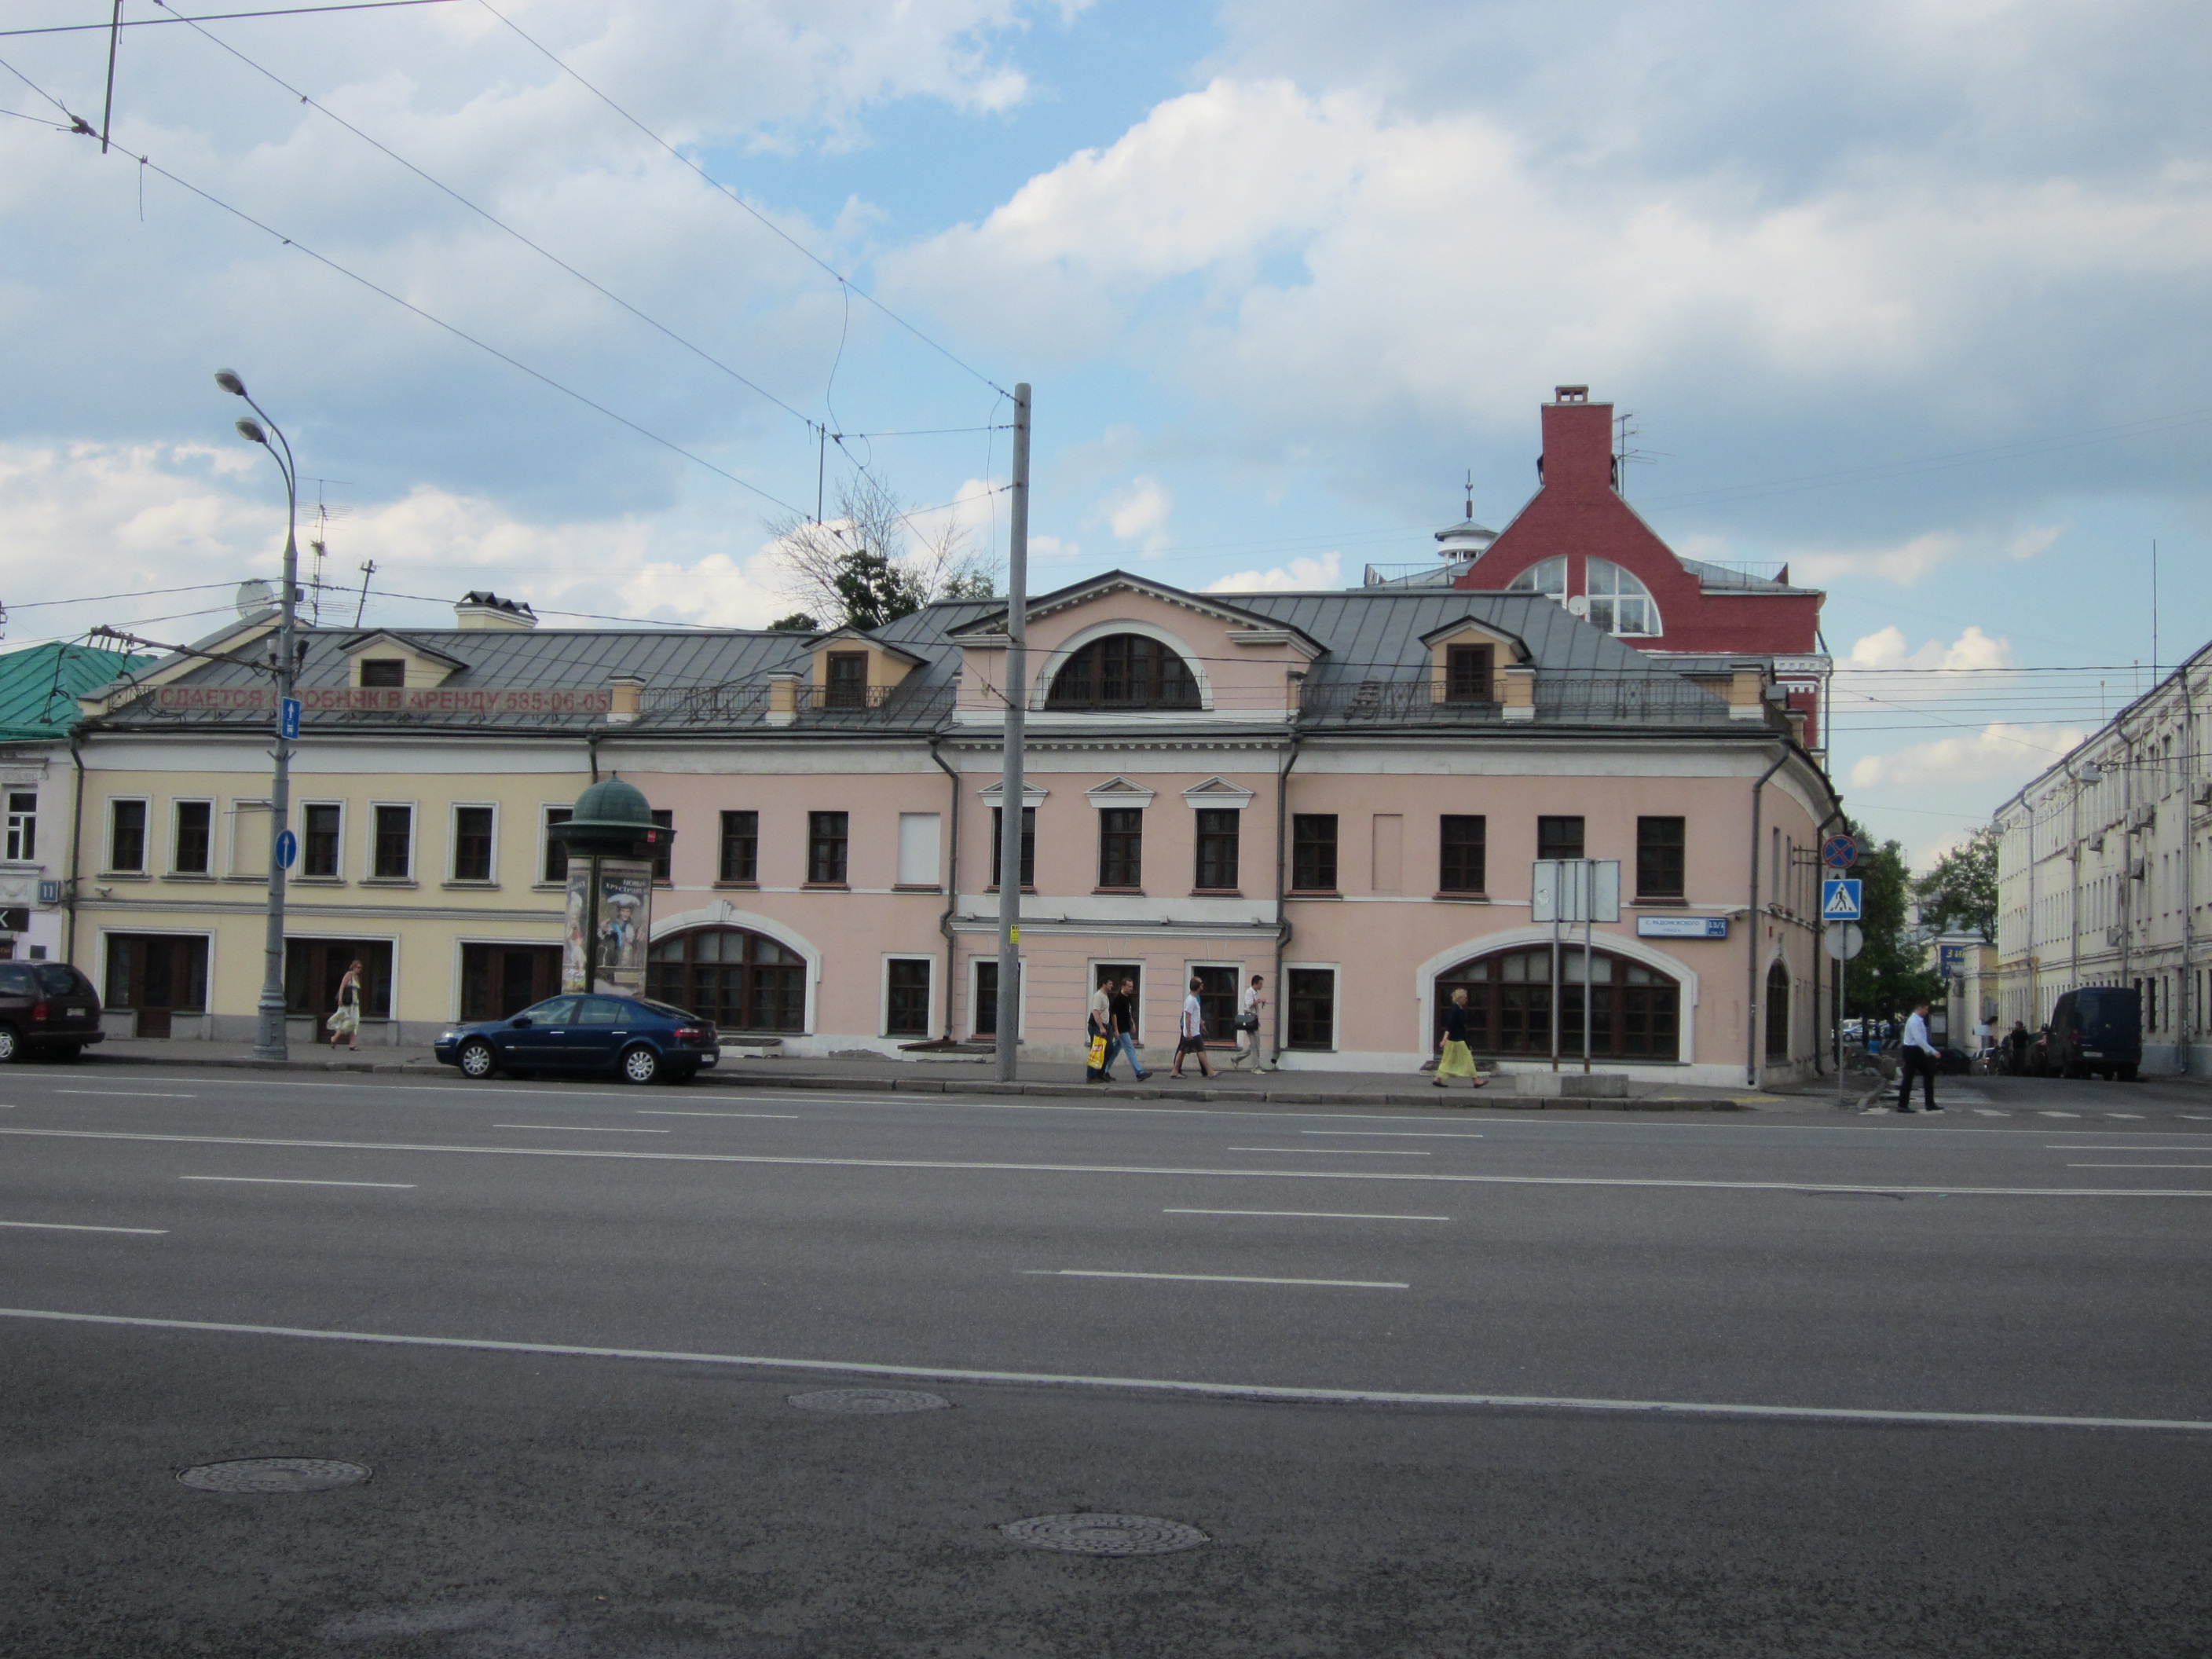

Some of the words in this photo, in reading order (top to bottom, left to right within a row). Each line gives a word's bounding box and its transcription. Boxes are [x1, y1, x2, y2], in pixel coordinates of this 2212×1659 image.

[159, 688, 263, 707] СДАЕТСЯ
[275, 690, 381, 709] ОБНЯК
[386, 691, 402, 709] В
[409, 691, 500, 711] АРЕНДУ
[506, 692, 609, 712] 585-06-05
[42, 884, 53, 898] 11
